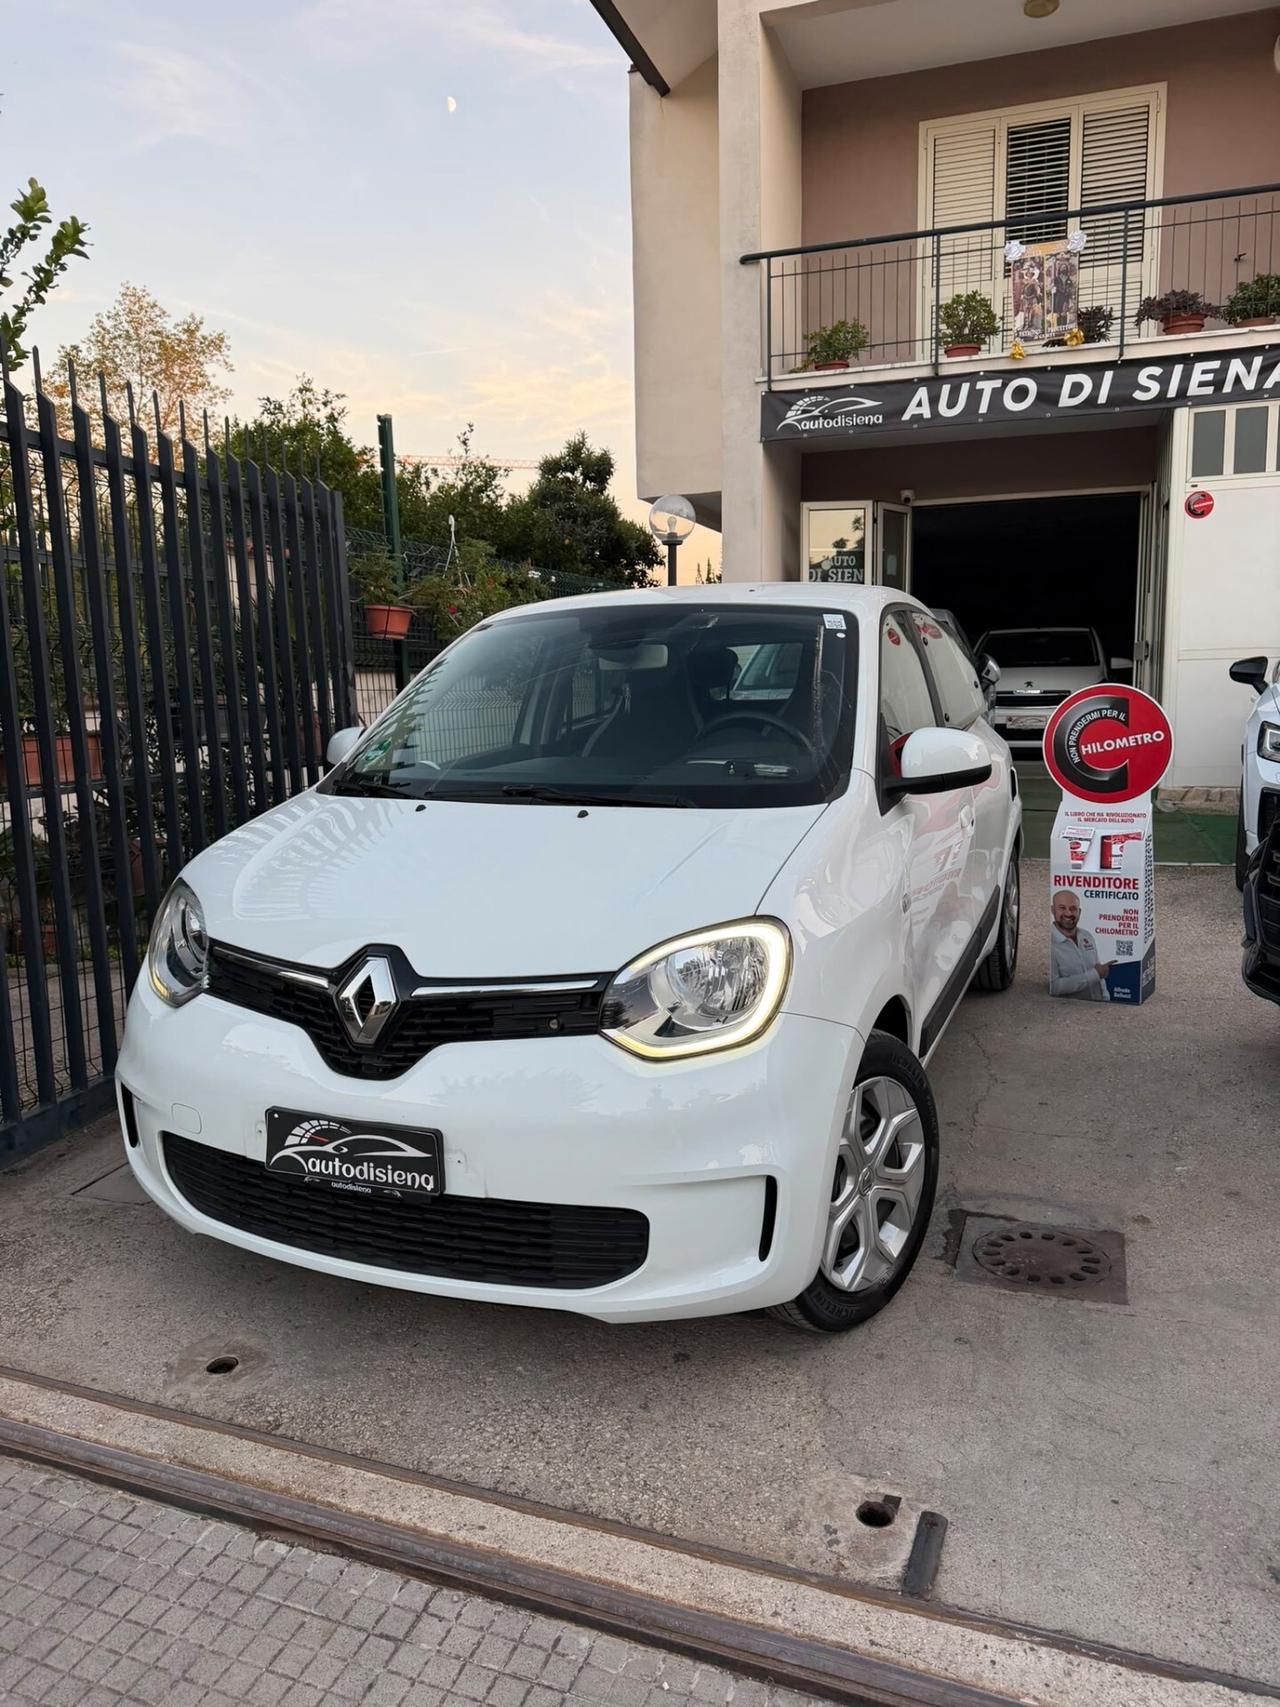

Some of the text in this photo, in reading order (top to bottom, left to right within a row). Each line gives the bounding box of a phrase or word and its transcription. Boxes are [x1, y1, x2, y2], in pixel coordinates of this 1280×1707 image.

[901, 377, 1038, 421] AUTO
[1058, 370, 1114, 408] DI
[801, 413, 883, 431] autodisiena
[1069, 709, 1127, 764] NON PRENDERMI PER IL
[1054, 874, 1139, 890] RIVENDITORE
[1084, 889, 1139, 901] CERTIFICATO
[1098, 914, 1139, 922] PRENDERMI
[1118, 921, 1139, 930] PER IL
[1095, 927, 1139, 937] CHILOMETRO
[307, 1156, 435, 1191] autodisiena
